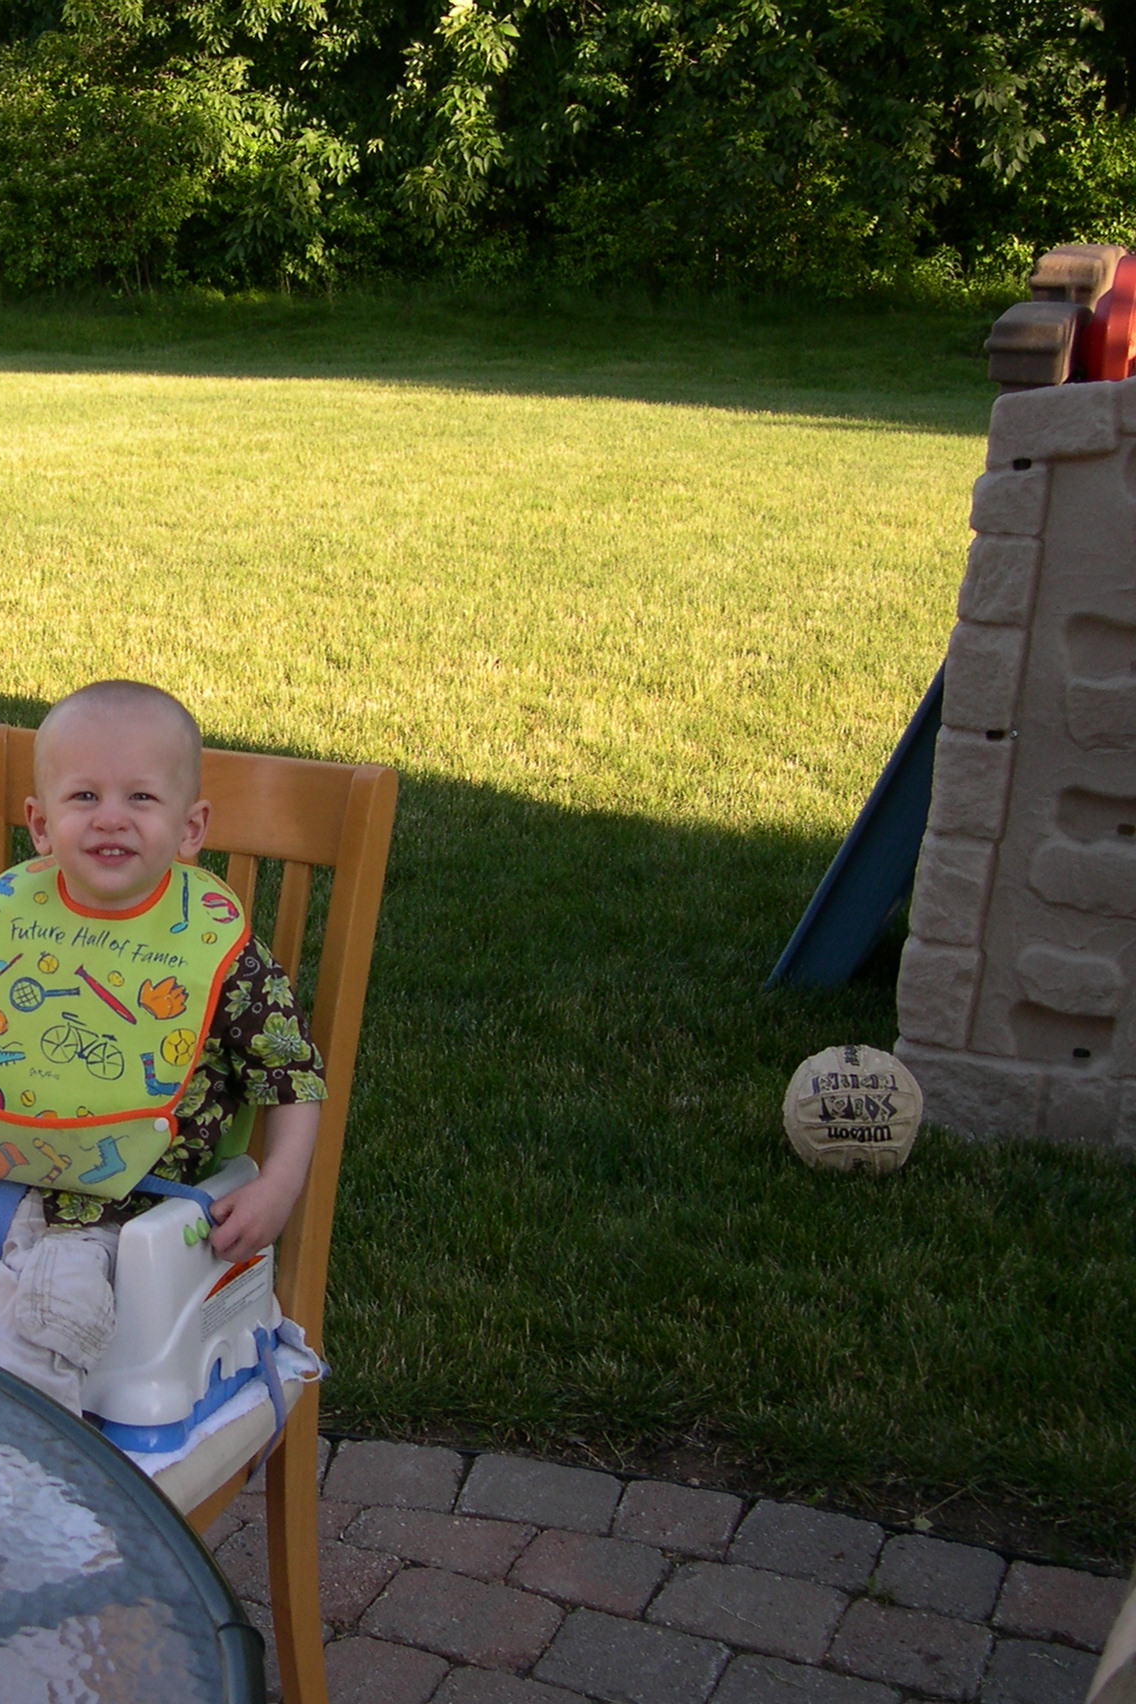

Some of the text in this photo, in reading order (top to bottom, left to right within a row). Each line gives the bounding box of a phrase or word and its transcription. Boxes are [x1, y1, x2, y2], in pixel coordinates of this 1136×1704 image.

[10, 916, 188, 968] Future Hall of Famer
[827, 1125, 892, 1142] Wilson
